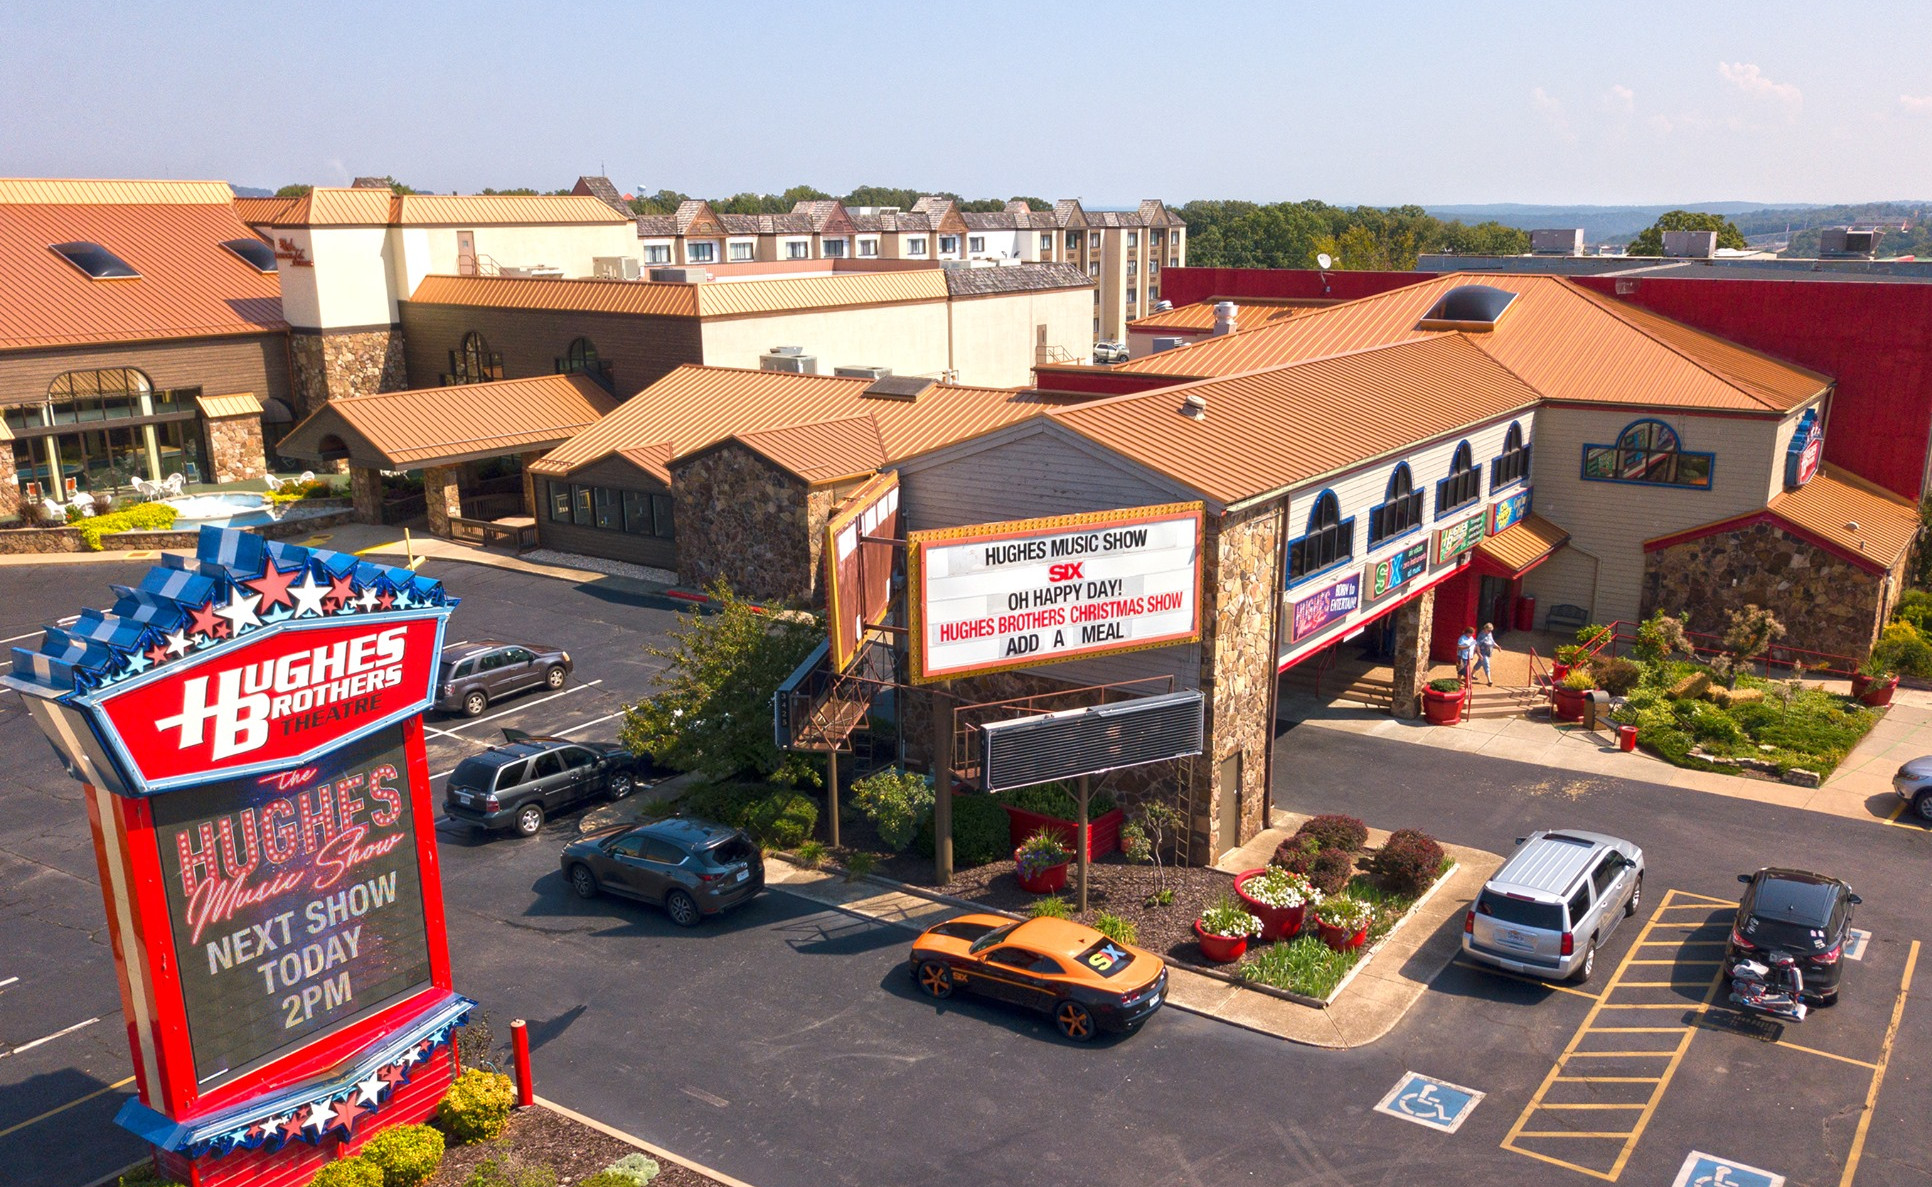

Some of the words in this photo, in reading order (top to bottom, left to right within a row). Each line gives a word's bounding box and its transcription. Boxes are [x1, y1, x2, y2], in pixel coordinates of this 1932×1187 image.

[985, 540, 1047, 566] HUGHES
[1050, 534, 1099, 558] MUSIC
[1103, 529, 1148, 551] SHOW
[1008, 592, 1029, 611] OH
[1033, 583, 1083, 607] HAPPY
[1087, 579, 1122, 600] DAY!
[1049, 562, 1084, 583] SIX
[1375, 552, 1402, 595] SIX
[940, 619, 995, 642] HUGHES
[998, 608, 1066, 634] BROTHERS
[1070, 599, 1144, 625] CHRISTMAS
[1147, 592, 1183, 615] SHOW
[1006, 633, 1040, 656] ADD
[1053, 629, 1065, 648] A
[1082, 622, 1124, 643] MEAL
[155, 625, 408, 750] HUGHES
[211, 664, 403, 761] BROTHERS
[281, 693, 383, 736] THEATRE
[175, 763, 402, 897] HUGHES
[186, 870, 303, 945] Music
[314, 826, 405, 888] Show
[206, 910, 295, 975] NEXT
[304, 871, 397, 934] SHOW
[257, 925, 362, 995] TODAY
[952, 971, 969, 983] SIX
[1088, 943, 1127, 971] SIX
[281, 971, 353, 1029] 2PM
